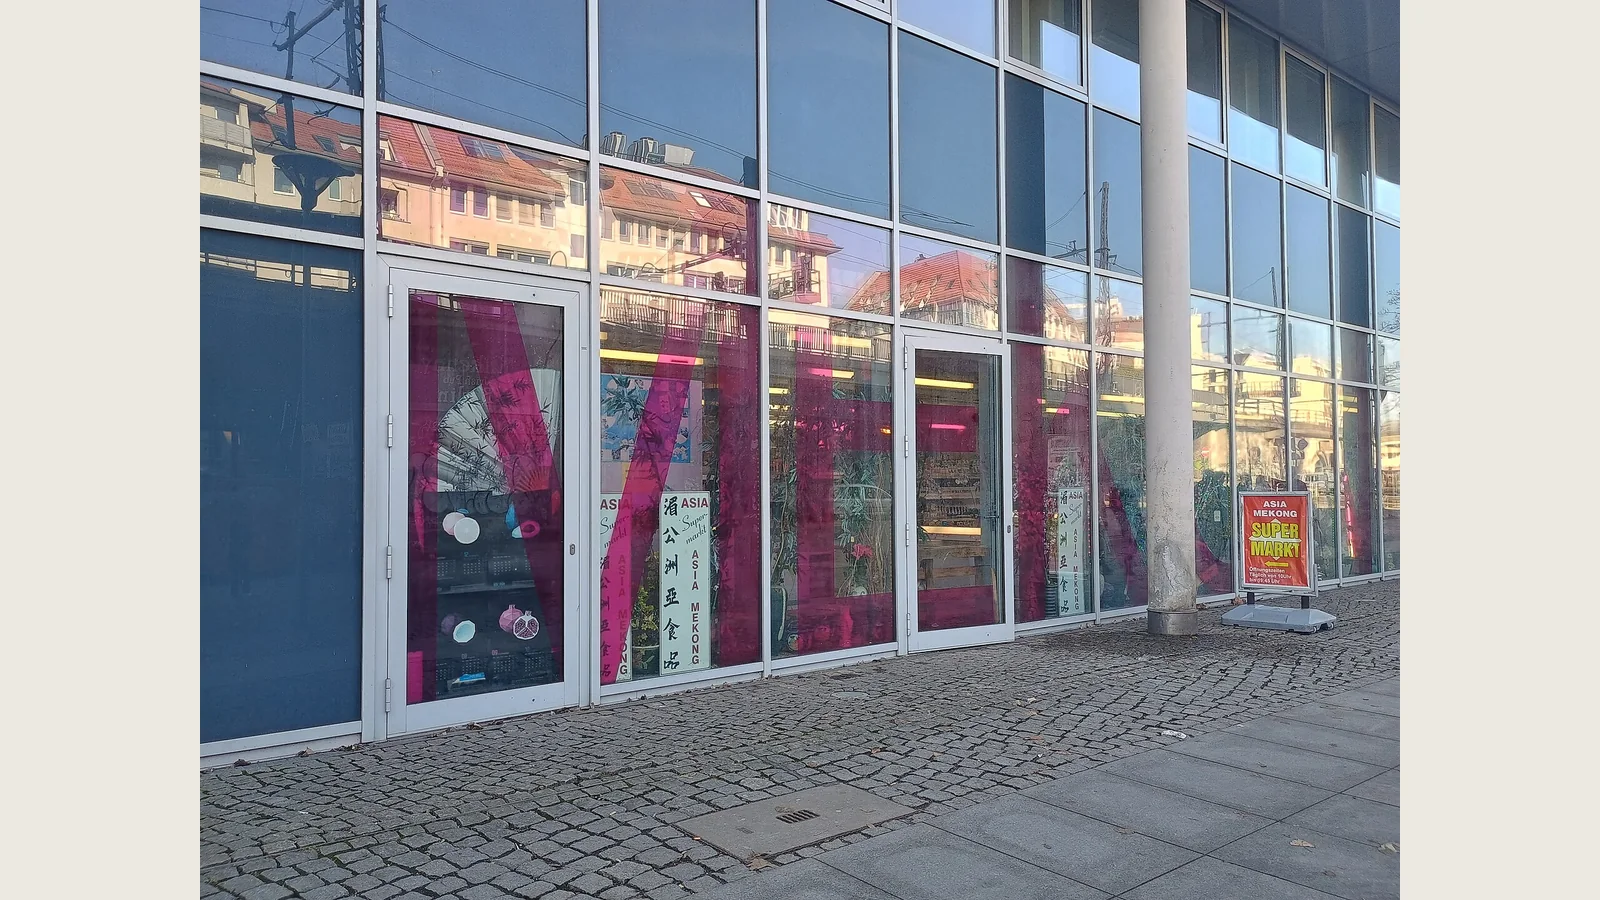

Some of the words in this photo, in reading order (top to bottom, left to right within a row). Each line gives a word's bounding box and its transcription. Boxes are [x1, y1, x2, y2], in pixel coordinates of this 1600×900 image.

[600, 498, 630, 510] ASIA
[681, 497, 709, 508] ASIA
[1069, 491, 1083, 500] ASIA
[1263, 500, 1287, 508] ASIA
[1253, 510, 1297, 518] MEKONG
[685, 524, 707, 545] markt
[1251, 522, 1299, 539] SUPER
[1250, 541, 1300, 558] MARKT
[618, 555, 626, 597] ASIA
[691, 550, 699, 590] ASIA
[663, 496, 680, 669] 湄公洲亞食品
[617, 608, 628, 674] MEKONG
[691, 602, 700, 664] MEKONG
